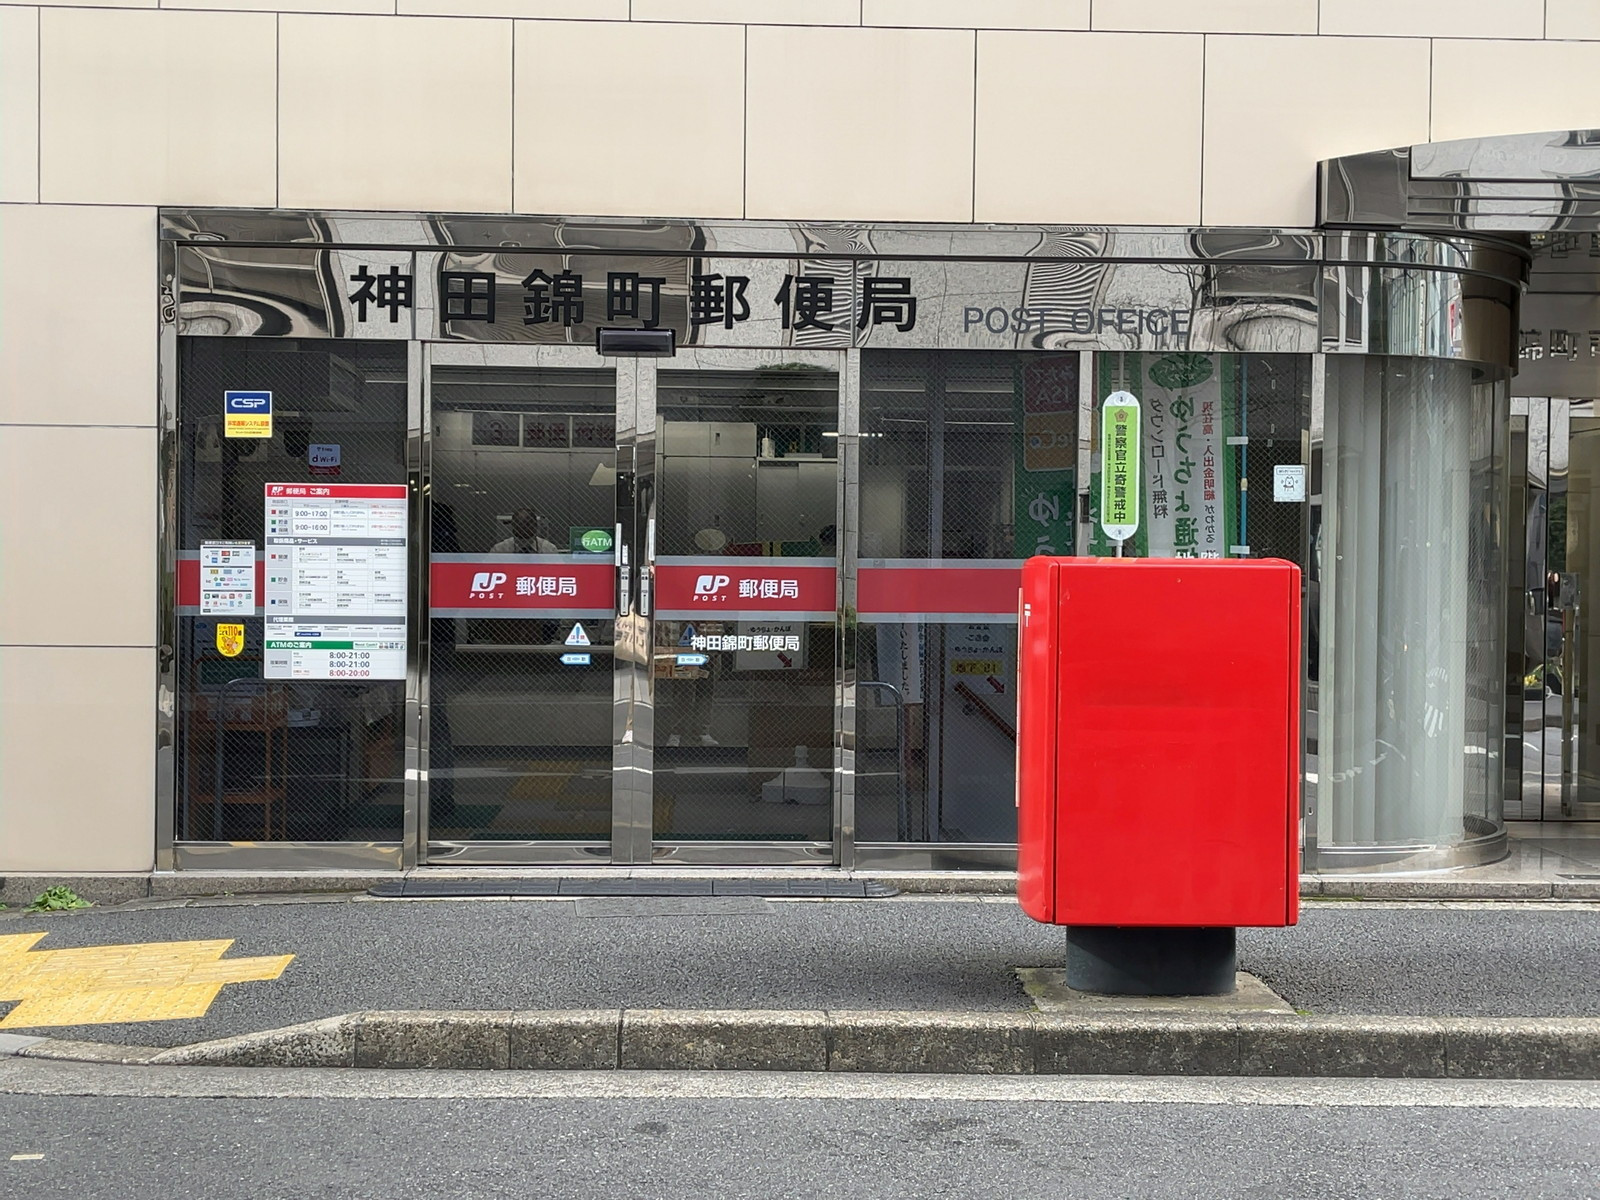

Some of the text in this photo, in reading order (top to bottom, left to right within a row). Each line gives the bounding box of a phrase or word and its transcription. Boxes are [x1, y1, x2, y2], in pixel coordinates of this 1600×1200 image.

[349, 265, 916, 331] 神田錦町郵便局
[964, 307, 1190, 336] POST OFFICE
[231, 398, 266, 408] CSP
[1114, 424, 1127, 523] 警察官立寄警戒中
[285, 487, 331, 496] 郵便局 ご案内
[577, 537, 613, 547] 行ATM
[515, 576, 577, 597] 郵便局
[738, 579, 799, 599] 郵便局
[270, 641, 313, 649] ATMのご案内
[690, 634, 800, 652] 神田錦町郵便局
[329, 651, 370, 659] 8:00-21:00
[899, 624, 911, 696] いたしました。
[329, 660, 370, 668] 8:00-21:00
[329, 669, 370, 677] 8:00-20:00
